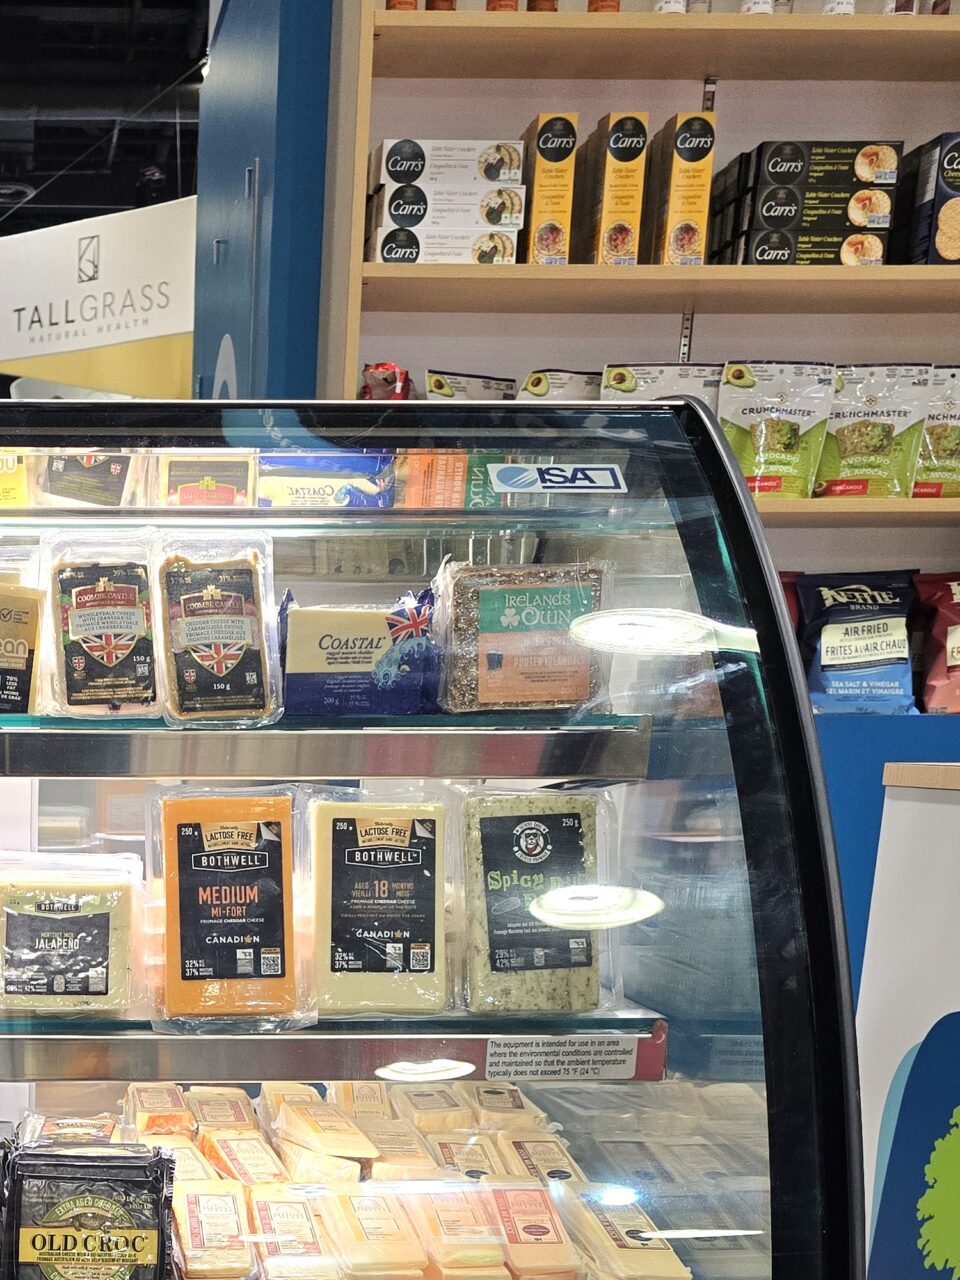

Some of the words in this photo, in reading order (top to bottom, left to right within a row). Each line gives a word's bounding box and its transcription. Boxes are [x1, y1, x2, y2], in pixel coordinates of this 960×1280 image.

[539, 134, 576, 149] Carr's
[609, 133, 646, 148] Carr's
[676, 133, 713, 149] Carr's
[387, 156, 424, 171] Carr's
[768, 157, 804, 173] Carr's
[391, 200, 427, 216] Carr's
[761, 202, 798, 218] Carr's
[383, 244, 419, 259] Carr's
[755, 246, 790, 261] Carr's
[14, 281, 171, 332] TALLGRASS
[29, 328, 87, 345] NATURAL
[97, 317, 149, 334] HEALTH
[741, 407, 815, 417] CRUNCHMASTER
[536, 467, 602, 486] ISA
[816, 584, 902, 609] KETTLE
[842, 626, 860, 637] AIR
[861, 622, 889, 635] FRIED
[318, 634, 383, 651] COASTAL
[336, 822, 348, 831] 250
[359, 826, 390, 838] LACTOSE
[391, 827, 409, 837] FREE
[205, 831, 235, 843] LACTOSE
[237, 831, 255, 841] FREE
[201, 853, 260, 867] BOTHWELL
[355, 851, 413, 863] BOTHWELL
[487, 870, 545, 892] Spicy
[198, 885, 259, 905] MEDIUM
[354, 882, 369, 890] AGED
[373, 880, 389, 898] 18
[40, 904, 76, 912] BOTHWELL
[211, 906, 247, 918] MI-FORT
[185, 960, 199, 968] 32%
[334, 952, 349, 961] 32%
[185, 968, 199, 976] 37%
[334, 960, 348, 969] 37%
[490, 1040, 502, 1049] The
[503, 1041, 534, 1050] equipment
[534, 1040, 541, 1048] is
[541, 1040, 568, 1048] intended
[568, 1040, 578, 1048] for
[489, 1050, 508, 1058] where
[508, 1050, 518, 1058] the
[519, 1049, 561, 1058] environmental
[561, 1049, 592, 1057] conditions
[603, 1048, 634, 1056] controlled
[488, 1060, 500, 1068] and
[501, 1059, 534, 1068] maintained
[543, 1059, 555, 1067] that
[555, 1059, 566, 1067] the
[566, 1059, 591, 1067] ambient
[591, 1059, 627, 1068] temperature
[487, 1069, 512, 1078] typically
[513, 1069, 528, 1077] does
[529, 1069, 539, 1077] not
[539, 1068, 562, 1076] exceed
[55, 1201, 76, 1216] EXTRA
[31, 1233, 78, 1252] OLD
[83, 1234, 146, 1253] CROC
